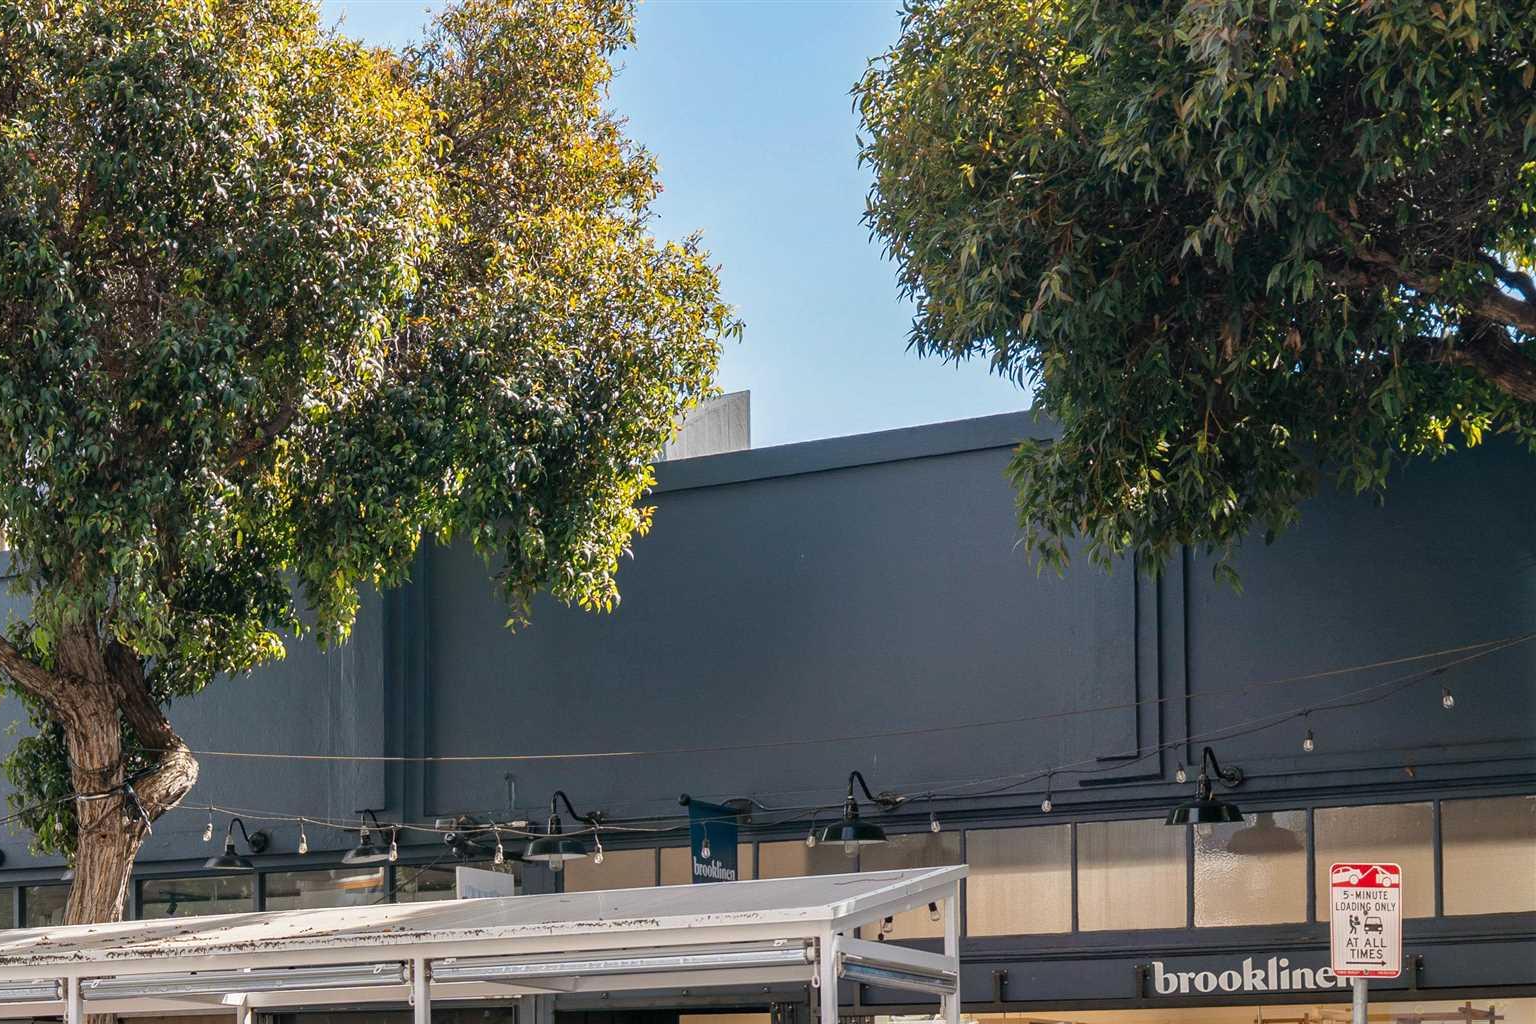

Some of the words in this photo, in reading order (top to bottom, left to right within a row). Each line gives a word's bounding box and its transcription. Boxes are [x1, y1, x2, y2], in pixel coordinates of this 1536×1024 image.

[693, 856, 735, 880] brooklinen
[1343, 890, 1388, 900] 5-MINUTE
[1335, 902, 1372, 911] LOADING
[1375, 902, 1396, 911] ONLY
[1346, 938, 1359, 947] AT
[1364, 938, 1387, 947] ALL
[1350, 949, 1383, 959] TIMES
